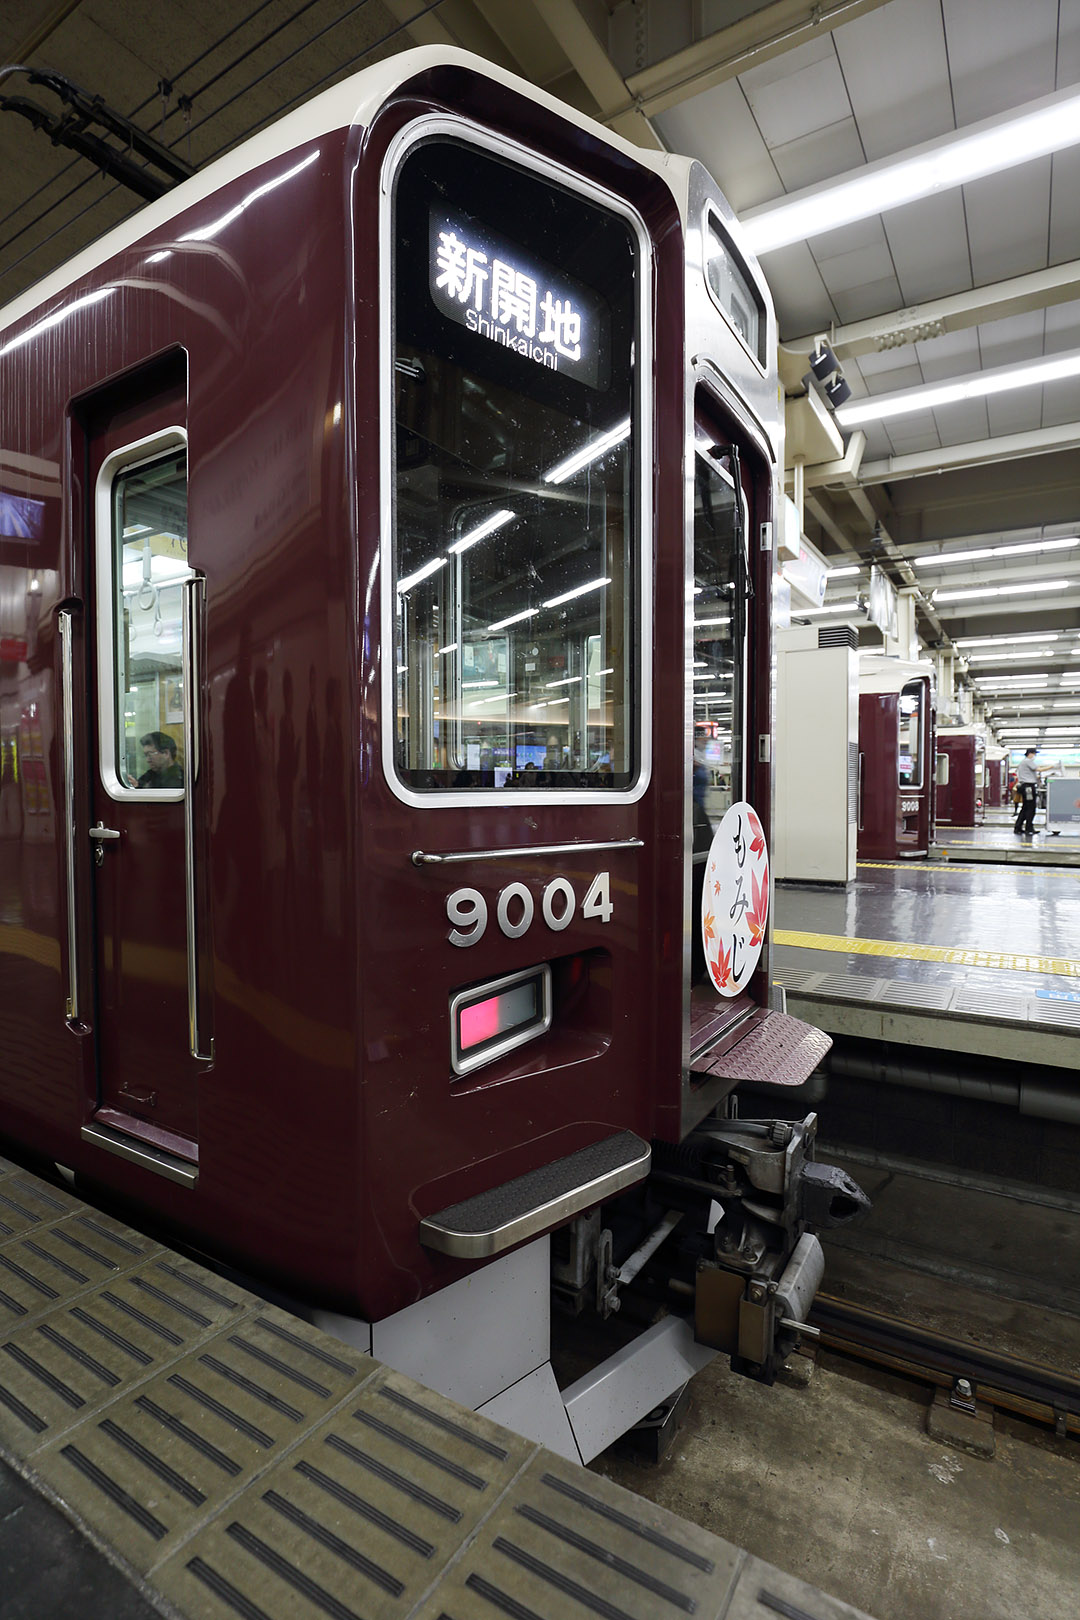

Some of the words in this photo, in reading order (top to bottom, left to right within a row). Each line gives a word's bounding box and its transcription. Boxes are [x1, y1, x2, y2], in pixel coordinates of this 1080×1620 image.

[436, 231, 581, 362] 新開地
[465, 309, 558, 371] Shinkaichi
[445, 871, 614, 948] 9004
[729, 814, 749, 983] もみじ
